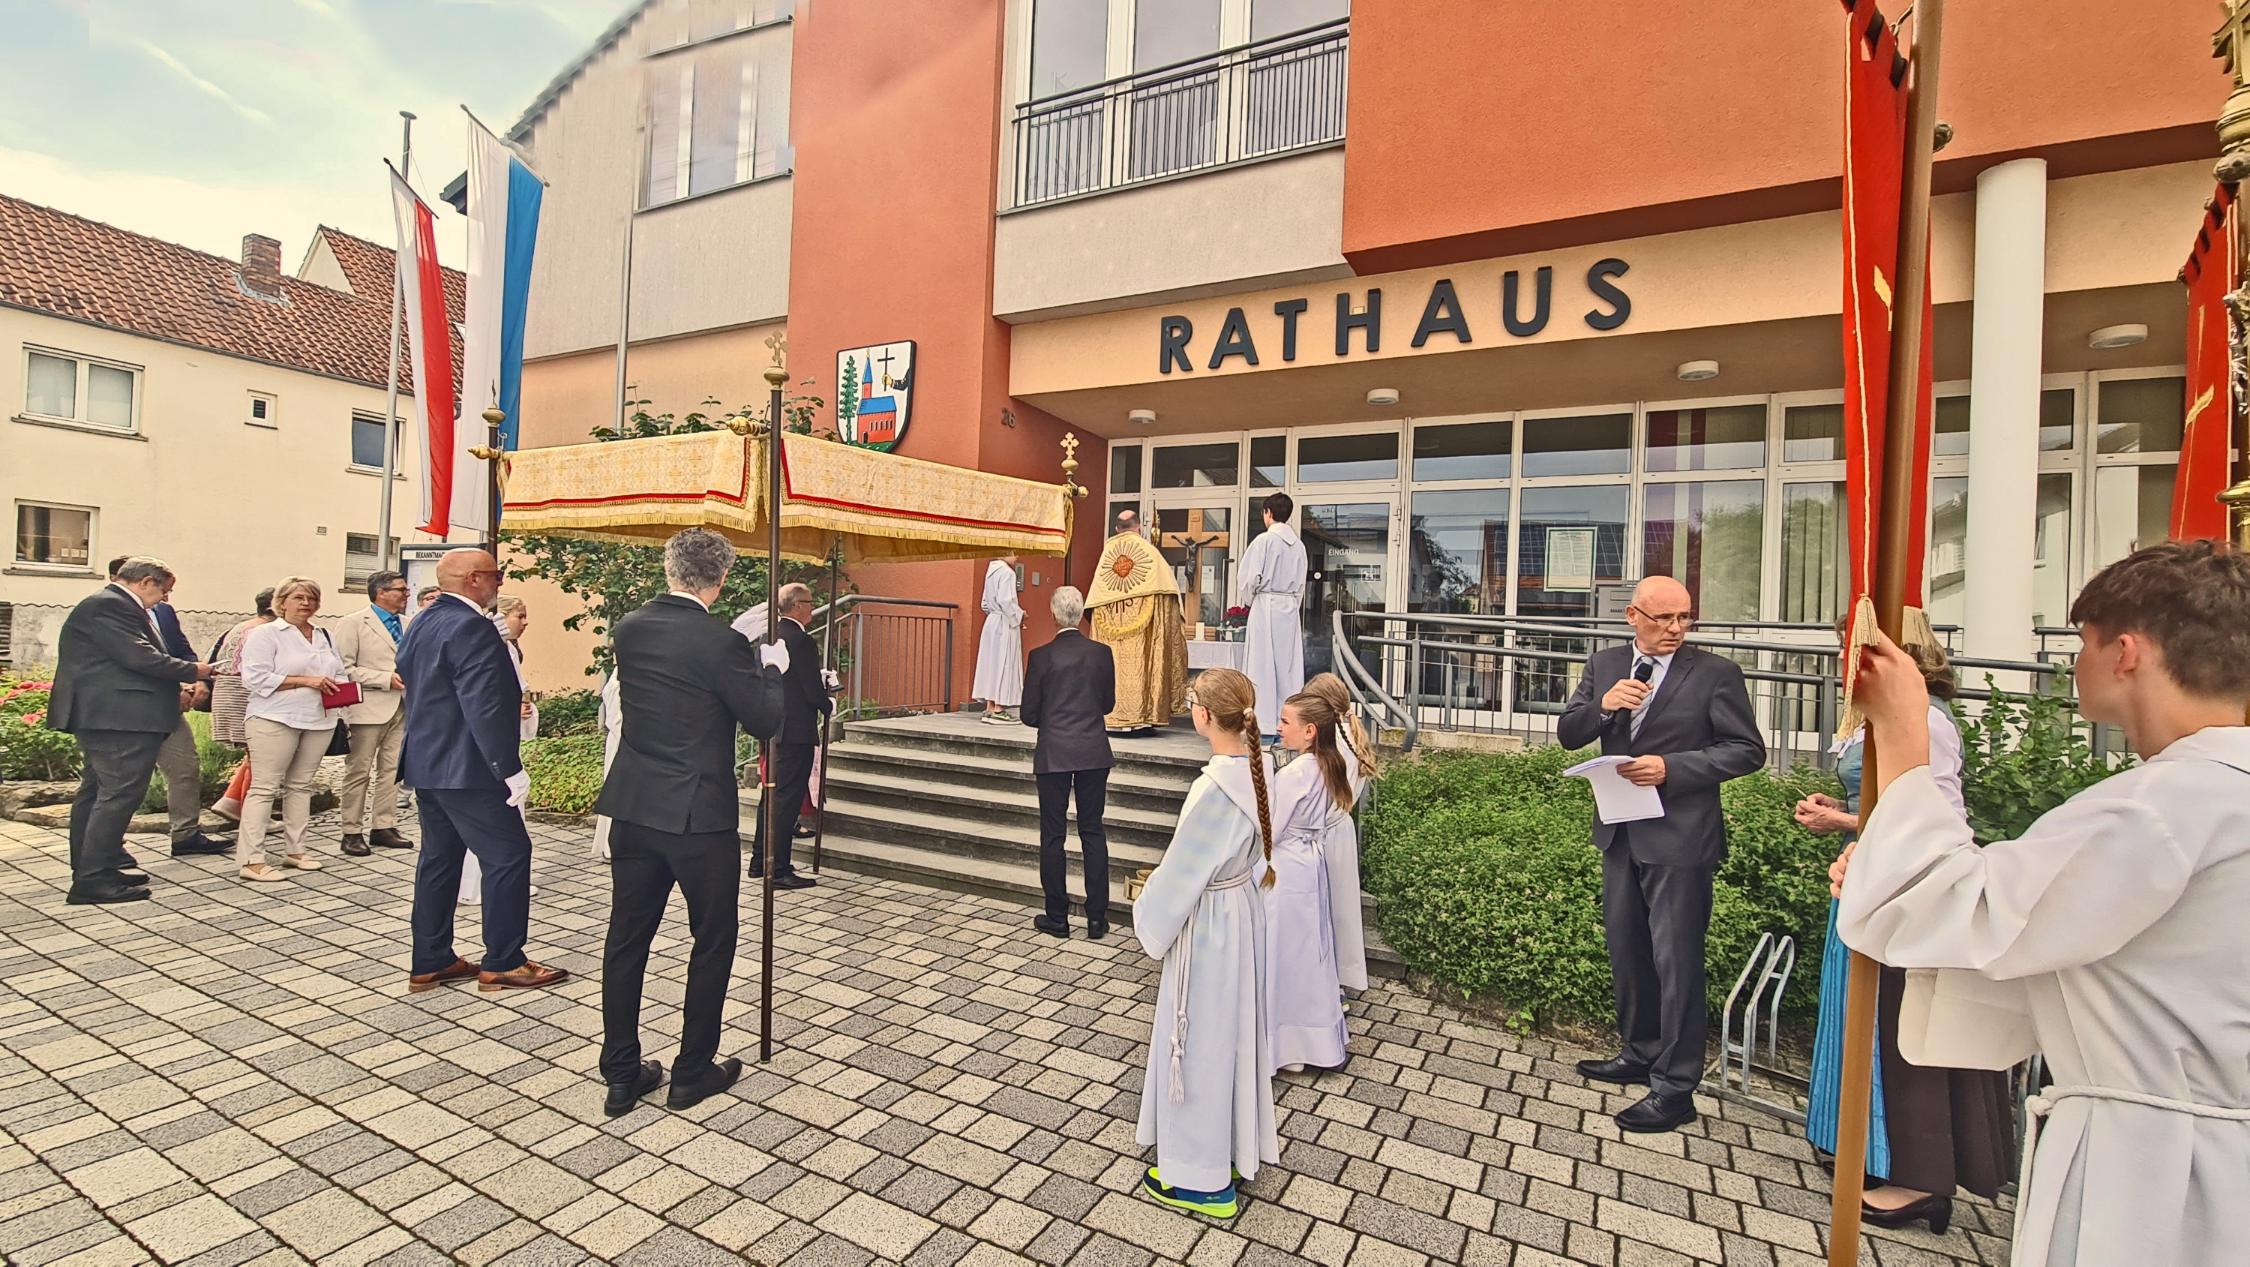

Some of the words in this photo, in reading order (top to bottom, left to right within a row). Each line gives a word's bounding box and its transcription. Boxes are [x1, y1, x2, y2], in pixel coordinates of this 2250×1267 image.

[1159, 258, 1631, 375] RATHAUS
[1001, 407, 1016, 429] 26
[1328, 548, 1359, 556] EINGANG
